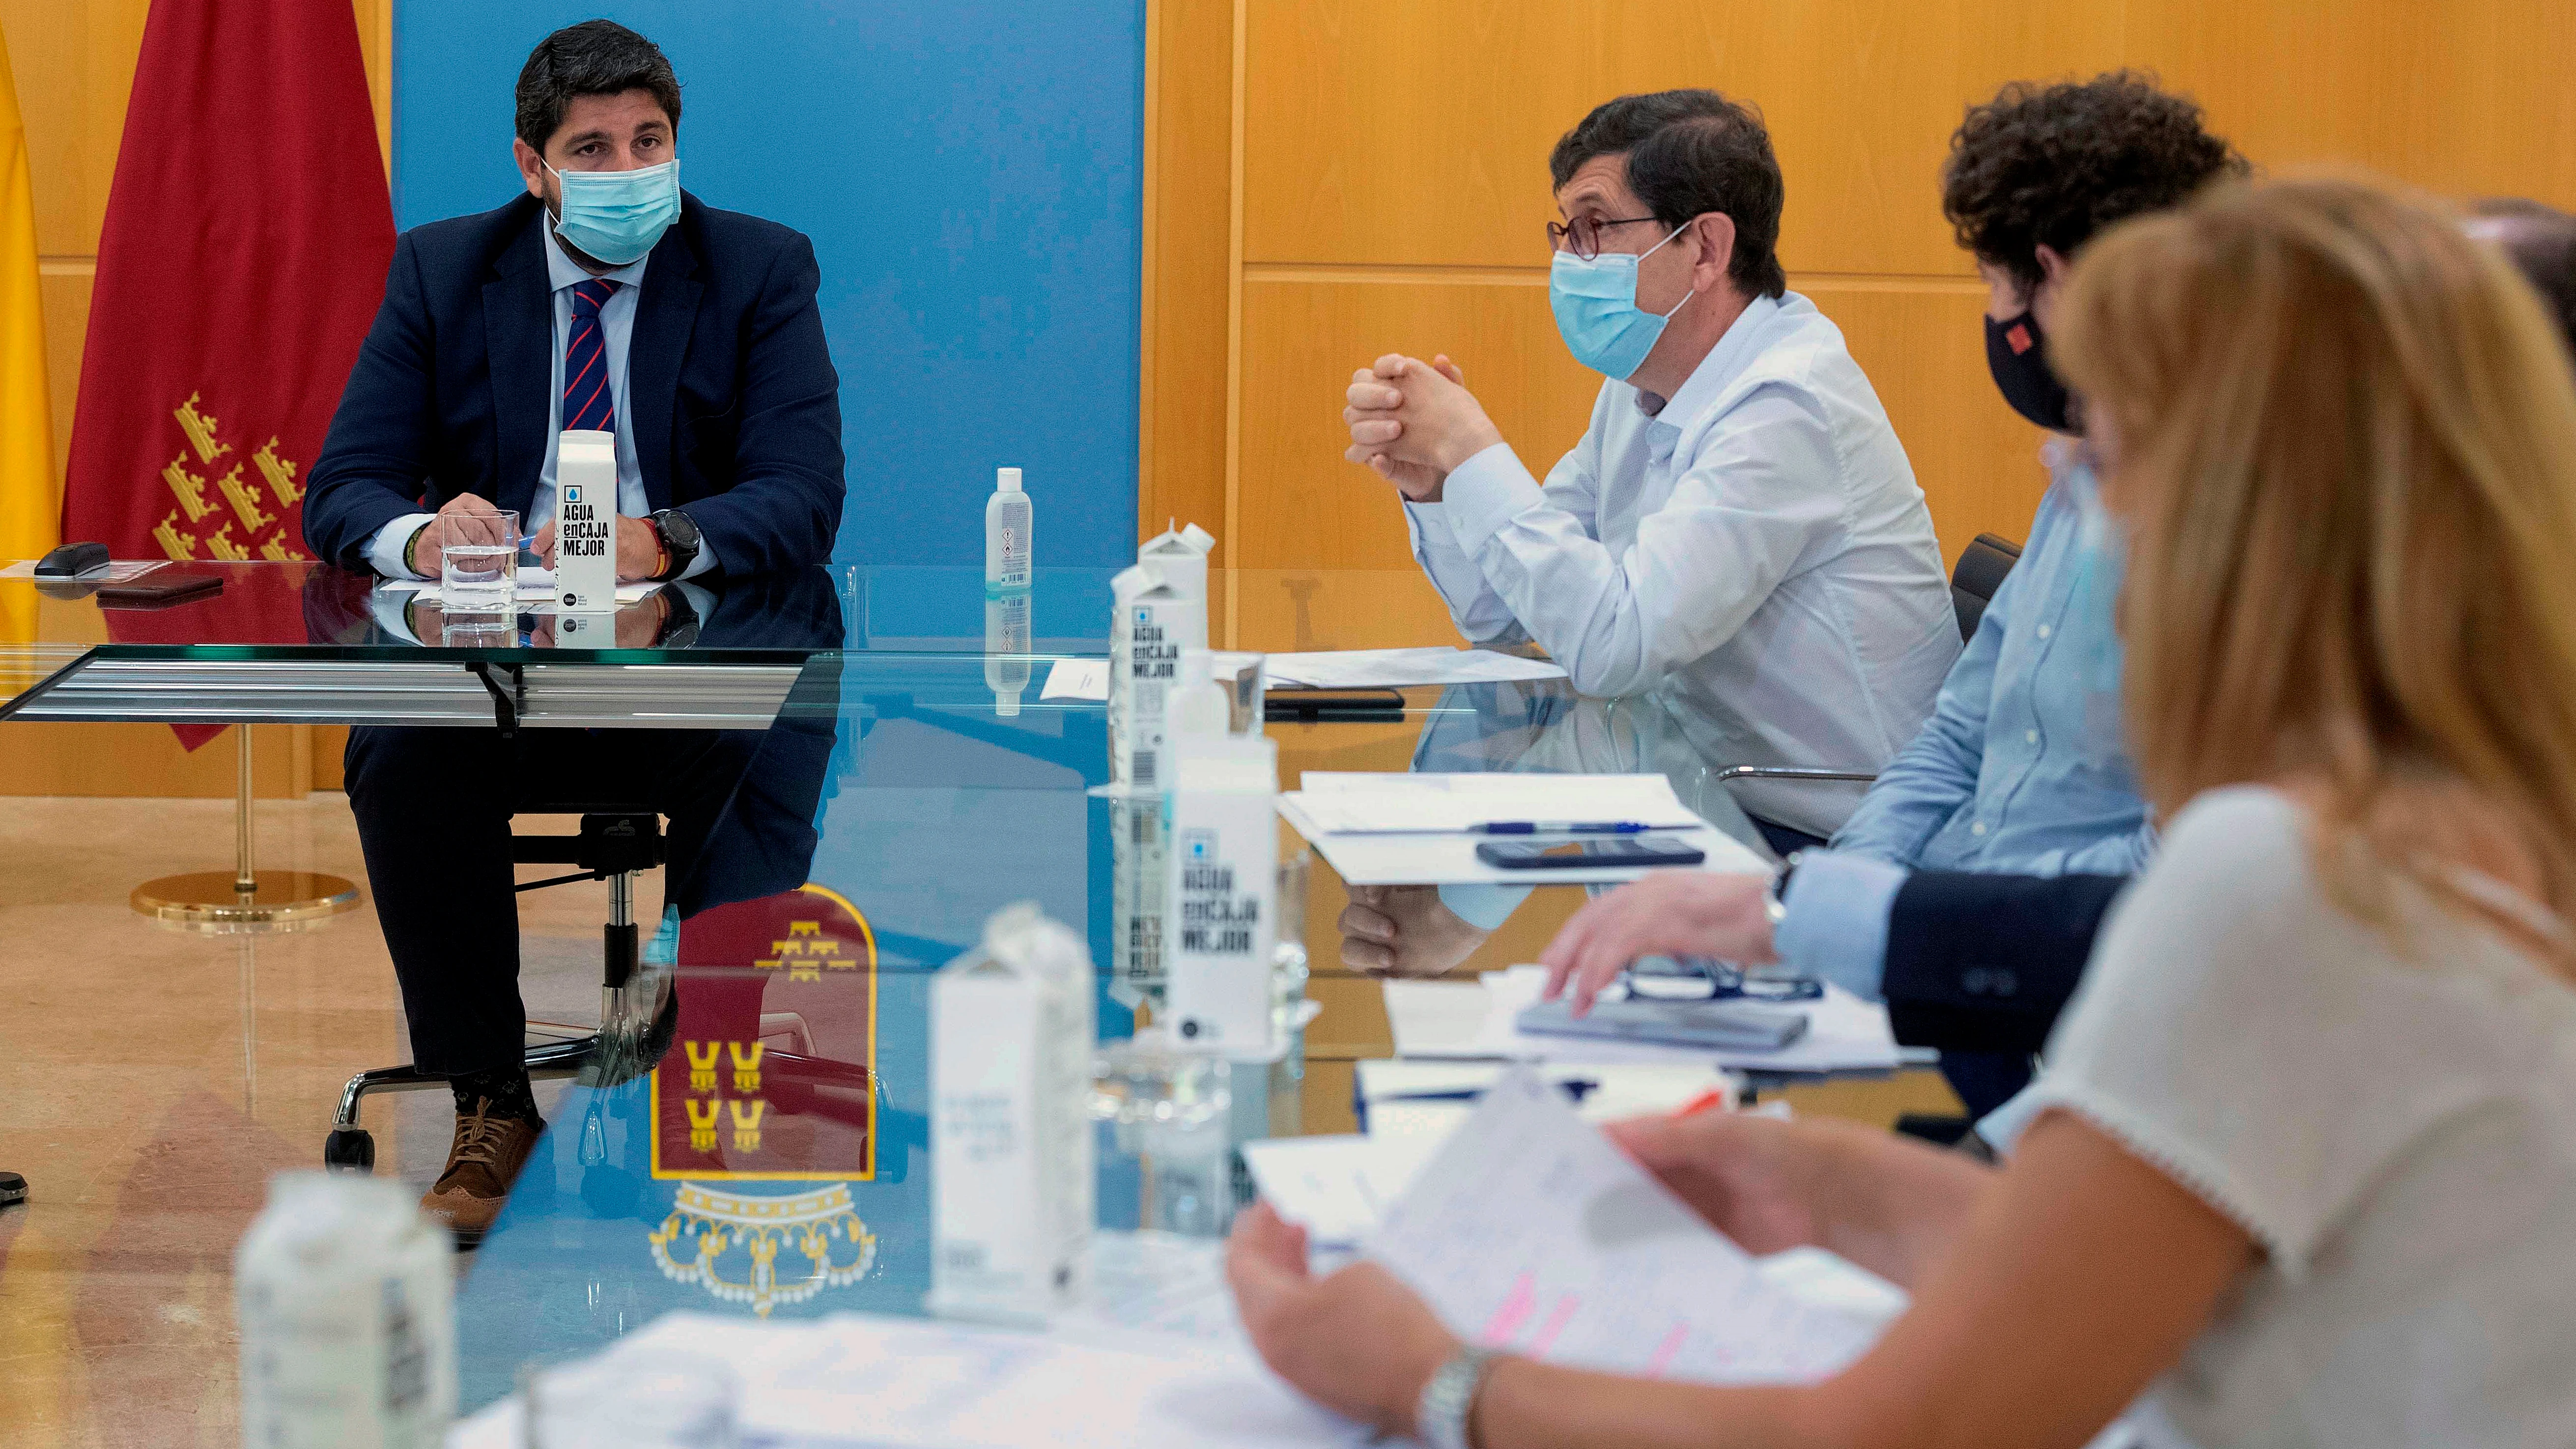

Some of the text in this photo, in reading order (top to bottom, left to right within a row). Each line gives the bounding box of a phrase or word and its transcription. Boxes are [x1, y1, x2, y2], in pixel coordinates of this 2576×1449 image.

[564, 505, 594, 521] AGUA
[564, 522, 609, 539] enCAJA
[564, 540, 605, 556] MEJOR
